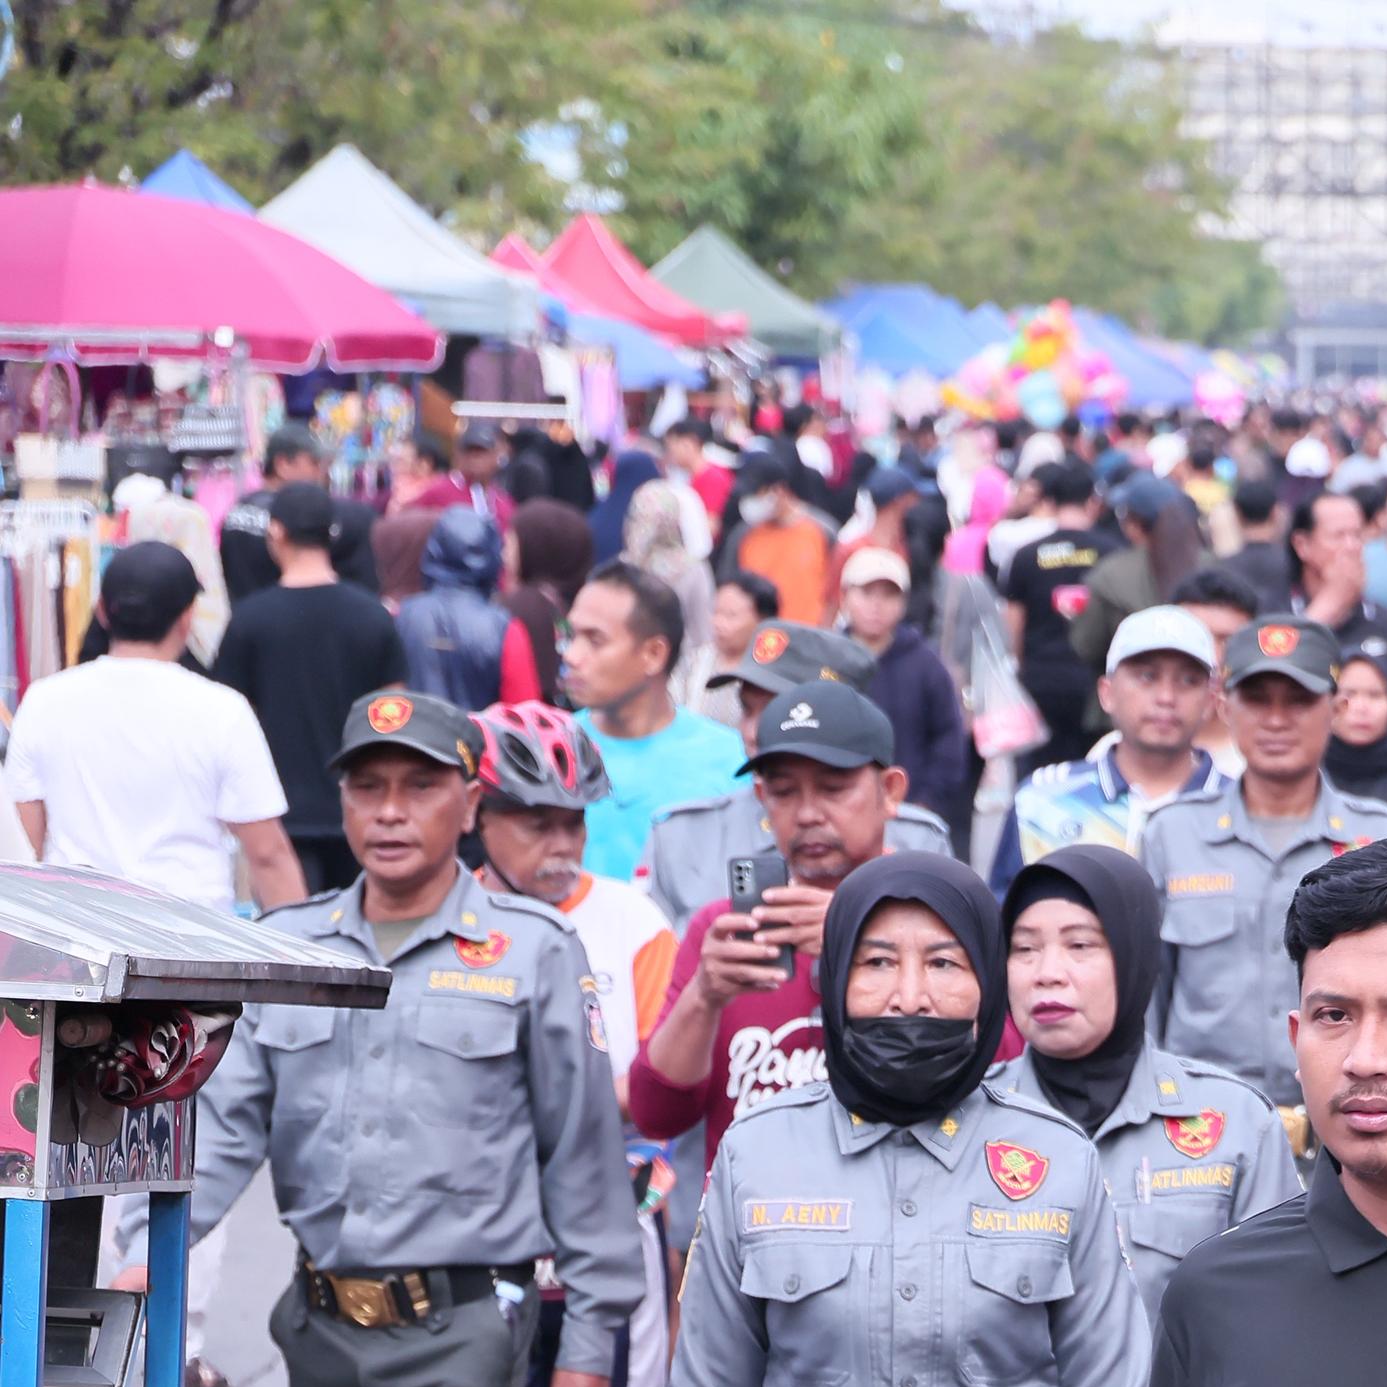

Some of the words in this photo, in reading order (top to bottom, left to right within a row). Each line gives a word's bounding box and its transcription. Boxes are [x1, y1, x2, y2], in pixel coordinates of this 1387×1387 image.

[428, 970, 514, 998] SATLINMAS
[1150, 1165, 1234, 1190] ATLINMAS
[751, 1204, 772, 1225] N.
[781, 1203, 841, 1224] AENY
[971, 1208, 1070, 1236] SATLINMAS
